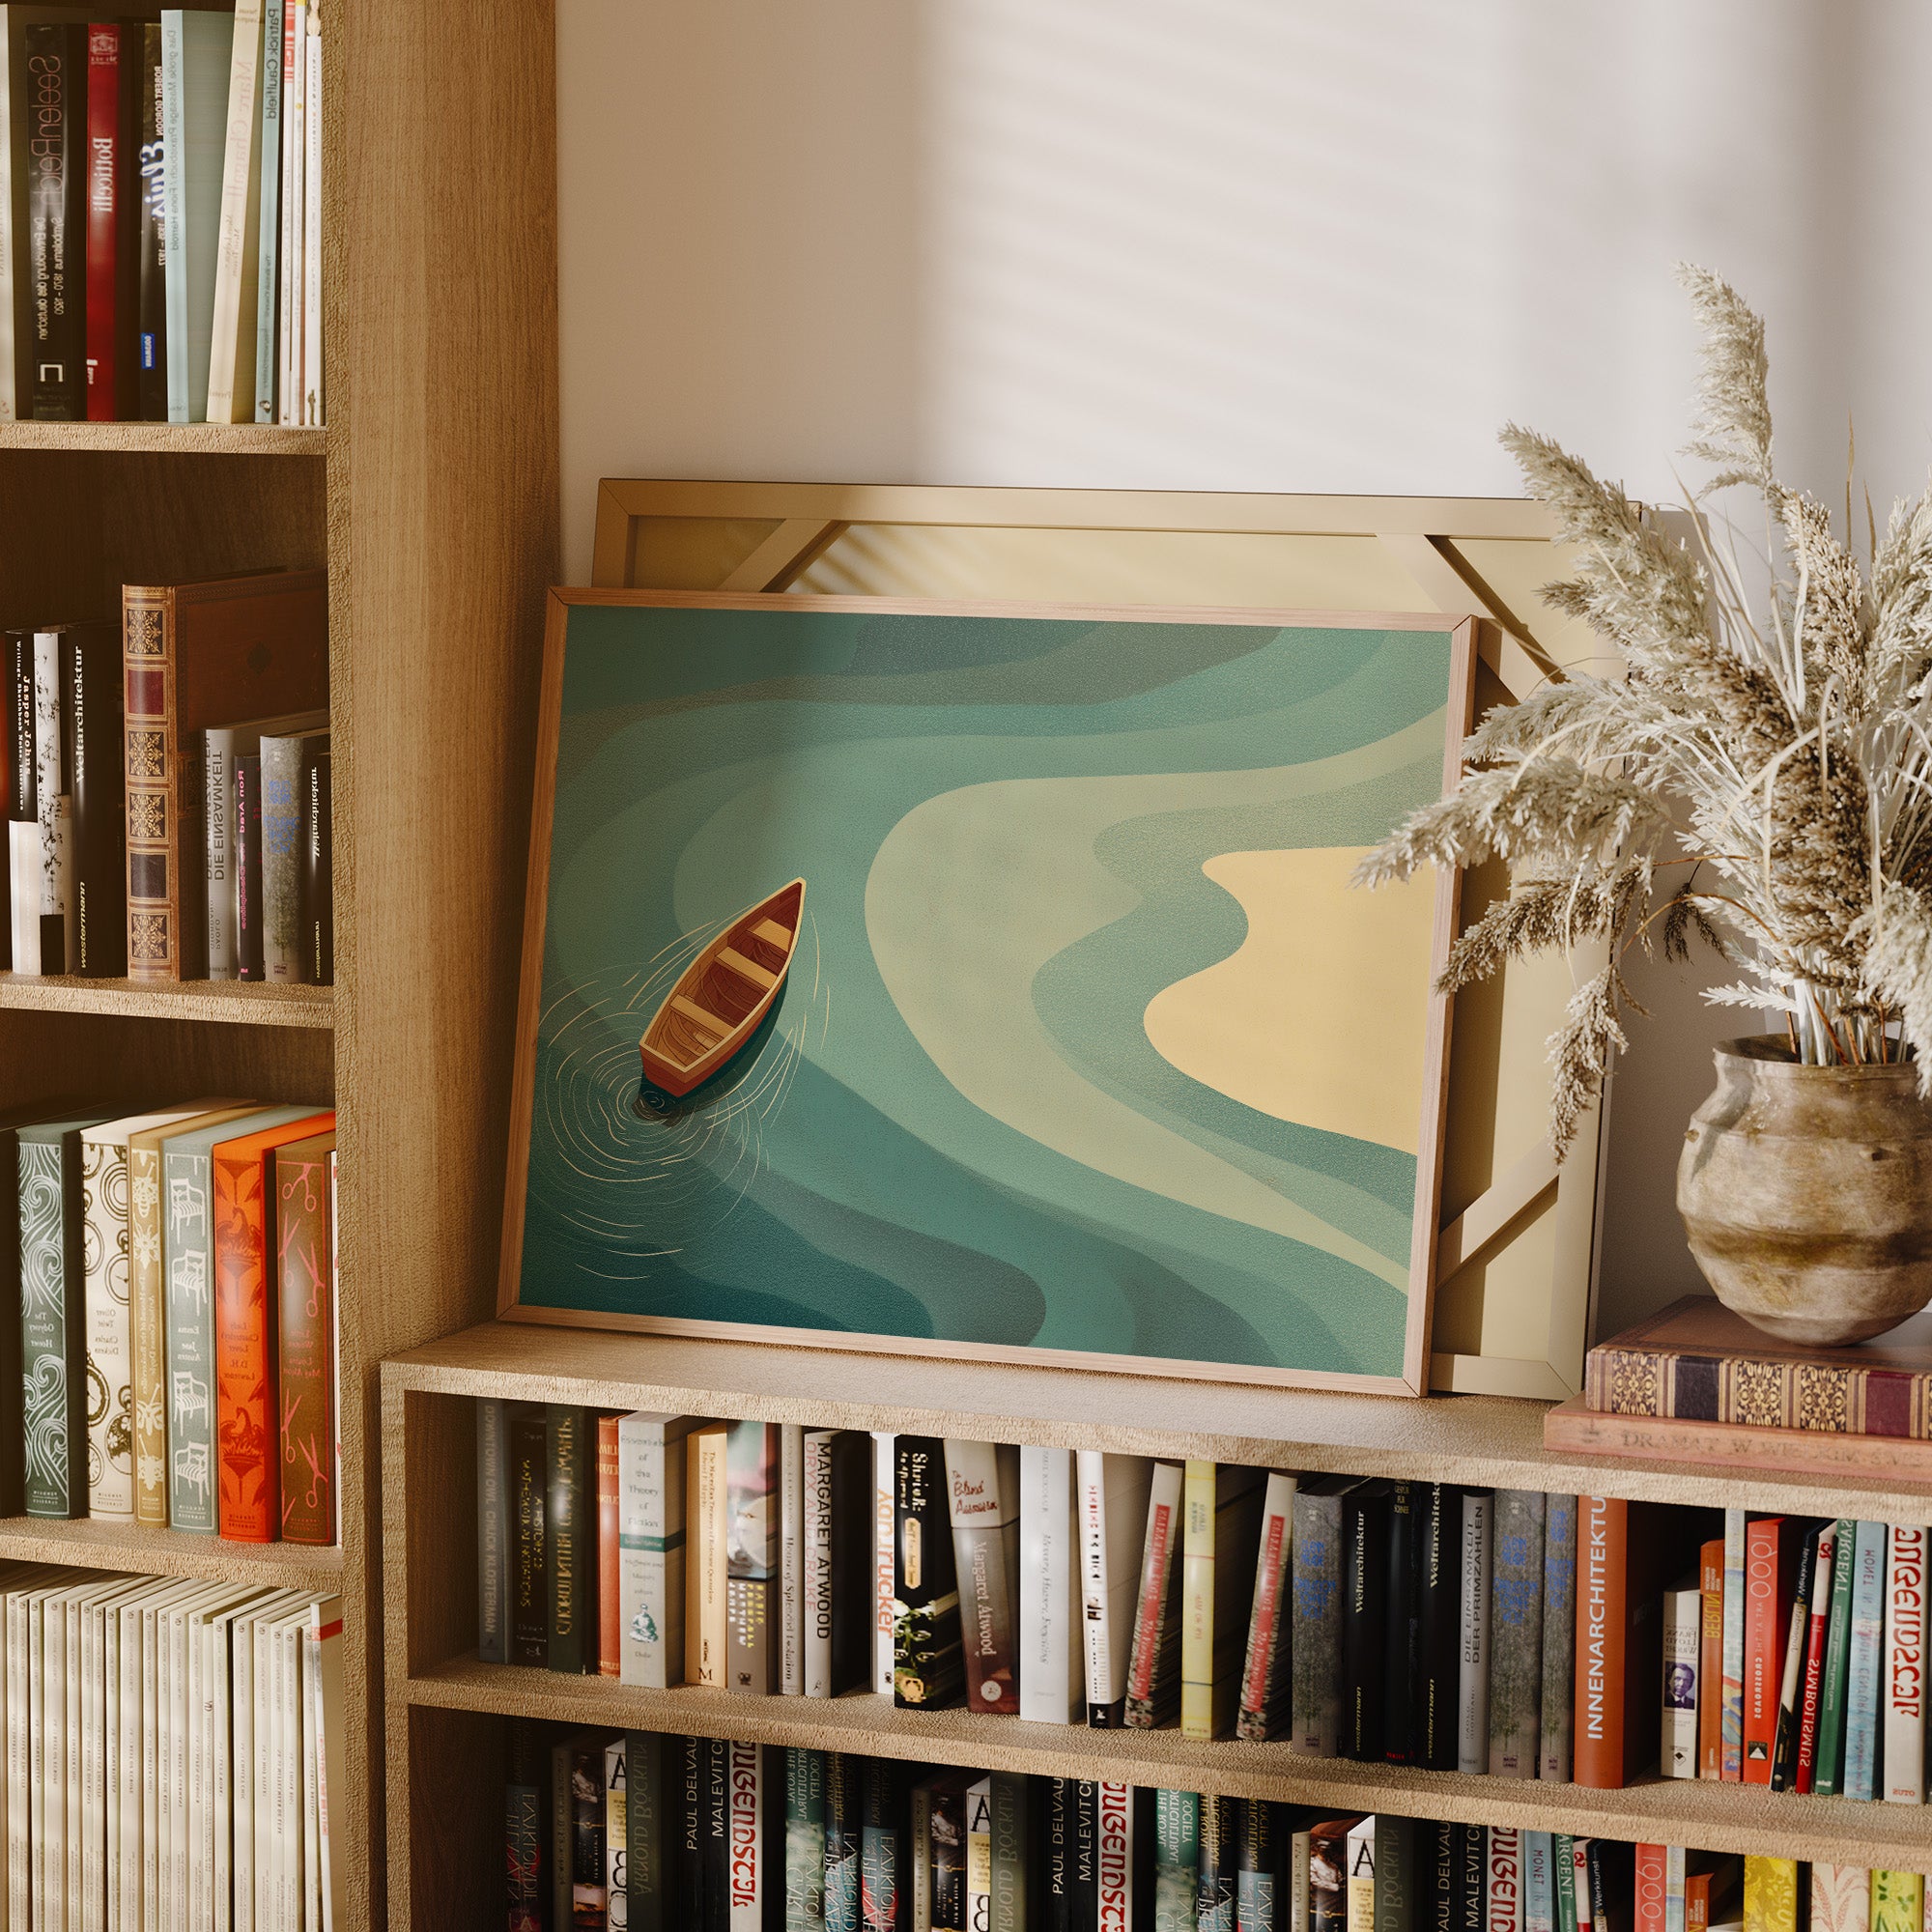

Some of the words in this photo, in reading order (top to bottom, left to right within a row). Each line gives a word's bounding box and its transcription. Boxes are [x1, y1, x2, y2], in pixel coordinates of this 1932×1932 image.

[74, 645, 85, 784] Weltarchitektur
[485, 1405, 497, 1477] DOWNTOWN
[639, 1453, 649, 1462] of
[805, 1441, 817, 1492] ORYX
[485, 1478, 497, 1504] OWL
[629, 1485, 659, 1497] Theory
[806, 1498, 817, 1539] AND
[817, 1441, 832, 1551] MARGARET
[485, 1510, 497, 1551] CHUCK
[1355, 1510, 1365, 1613] Weltarchitektur
[485, 1553, 497, 1634] KLOSTERMAN
[806, 1547, 818, 1612] CRAKE
[972, 1541, 989, 1601] Margaret
[1465, 1522, 1474, 1629] EINSAMKEIT
[1473, 1505, 1484, 1622] PRIMZAHLEN
[816, 1556, 831, 1639] ATWOOD
[1587, 1496, 1607, 1740] INNENARCHITEKTU
[978, 1603, 997, 1656] Atwood
[1472, 1627, 1481, 1663] DER
[686, 1736, 698, 1803] DELVAU
[686, 1807, 697, 1850] PAUL
[1052, 1776, 1065, 1846] DELVAU
[1052, 1853, 1064, 1894] PAUL
[1351, 1837, 1376, 1878] A
[1437, 1821, 1450, 1889] DELVAU
[1532, 1849, 1545, 1887] MONET
[1594, 1860, 1604, 1908] Werkkunst
[1635, 1856, 1662, 1920] 1900
